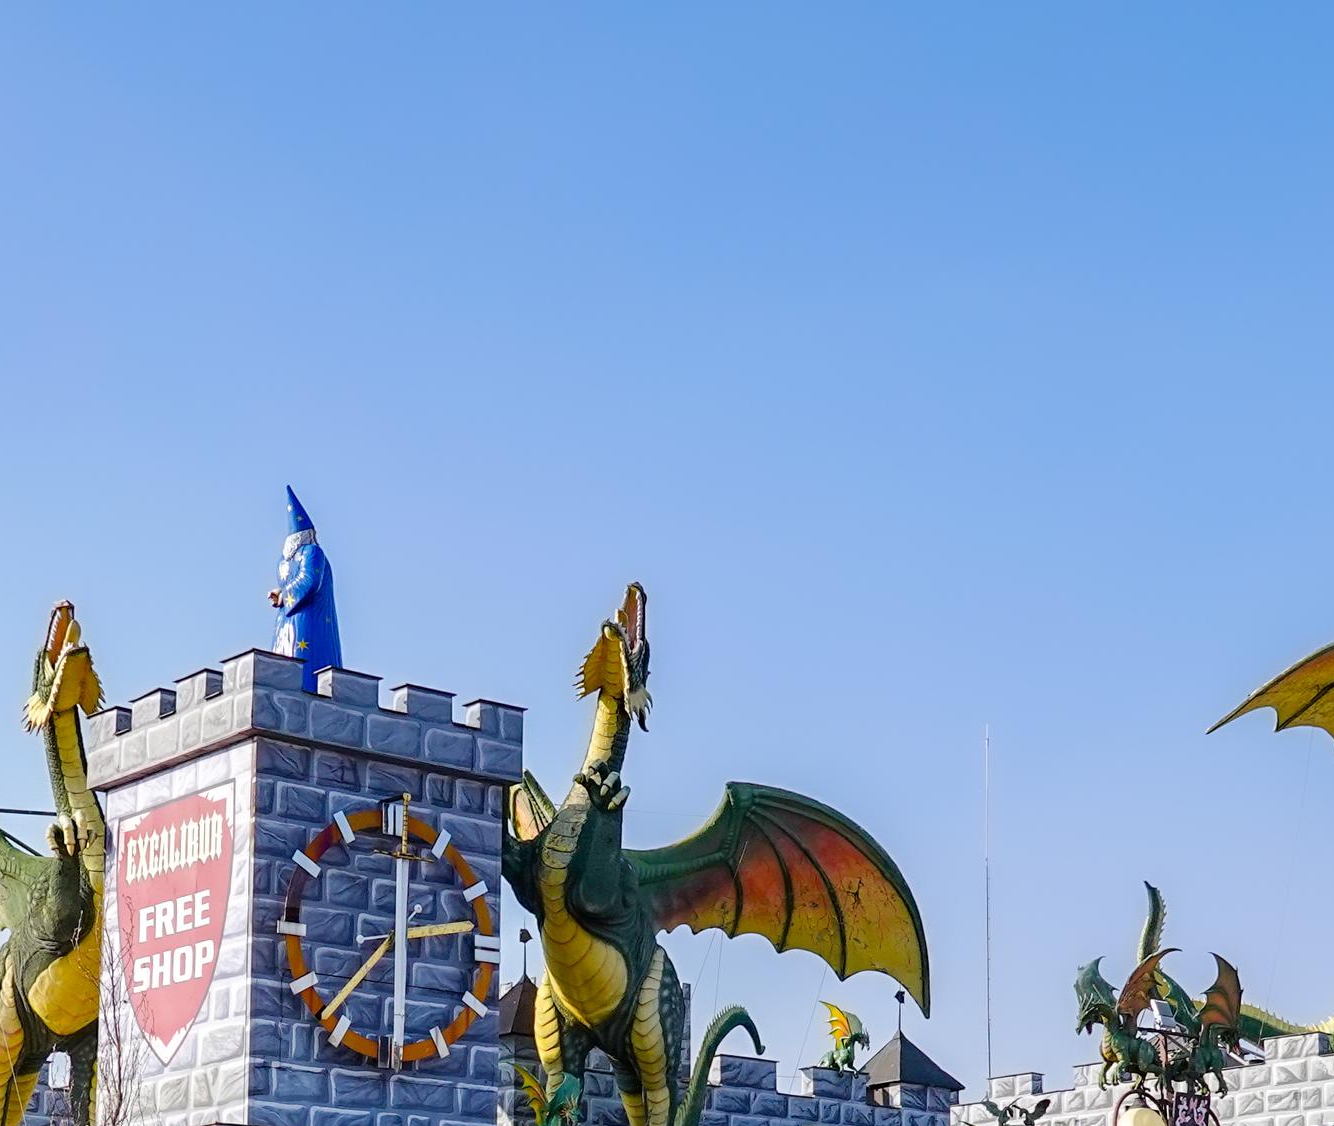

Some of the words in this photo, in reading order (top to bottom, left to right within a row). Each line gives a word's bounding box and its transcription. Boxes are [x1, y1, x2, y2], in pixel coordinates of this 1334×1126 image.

[125, 810, 223, 886] EXCALIBUR
[138, 889, 212, 943] FREE
[133, 940, 214, 994] SHOP
